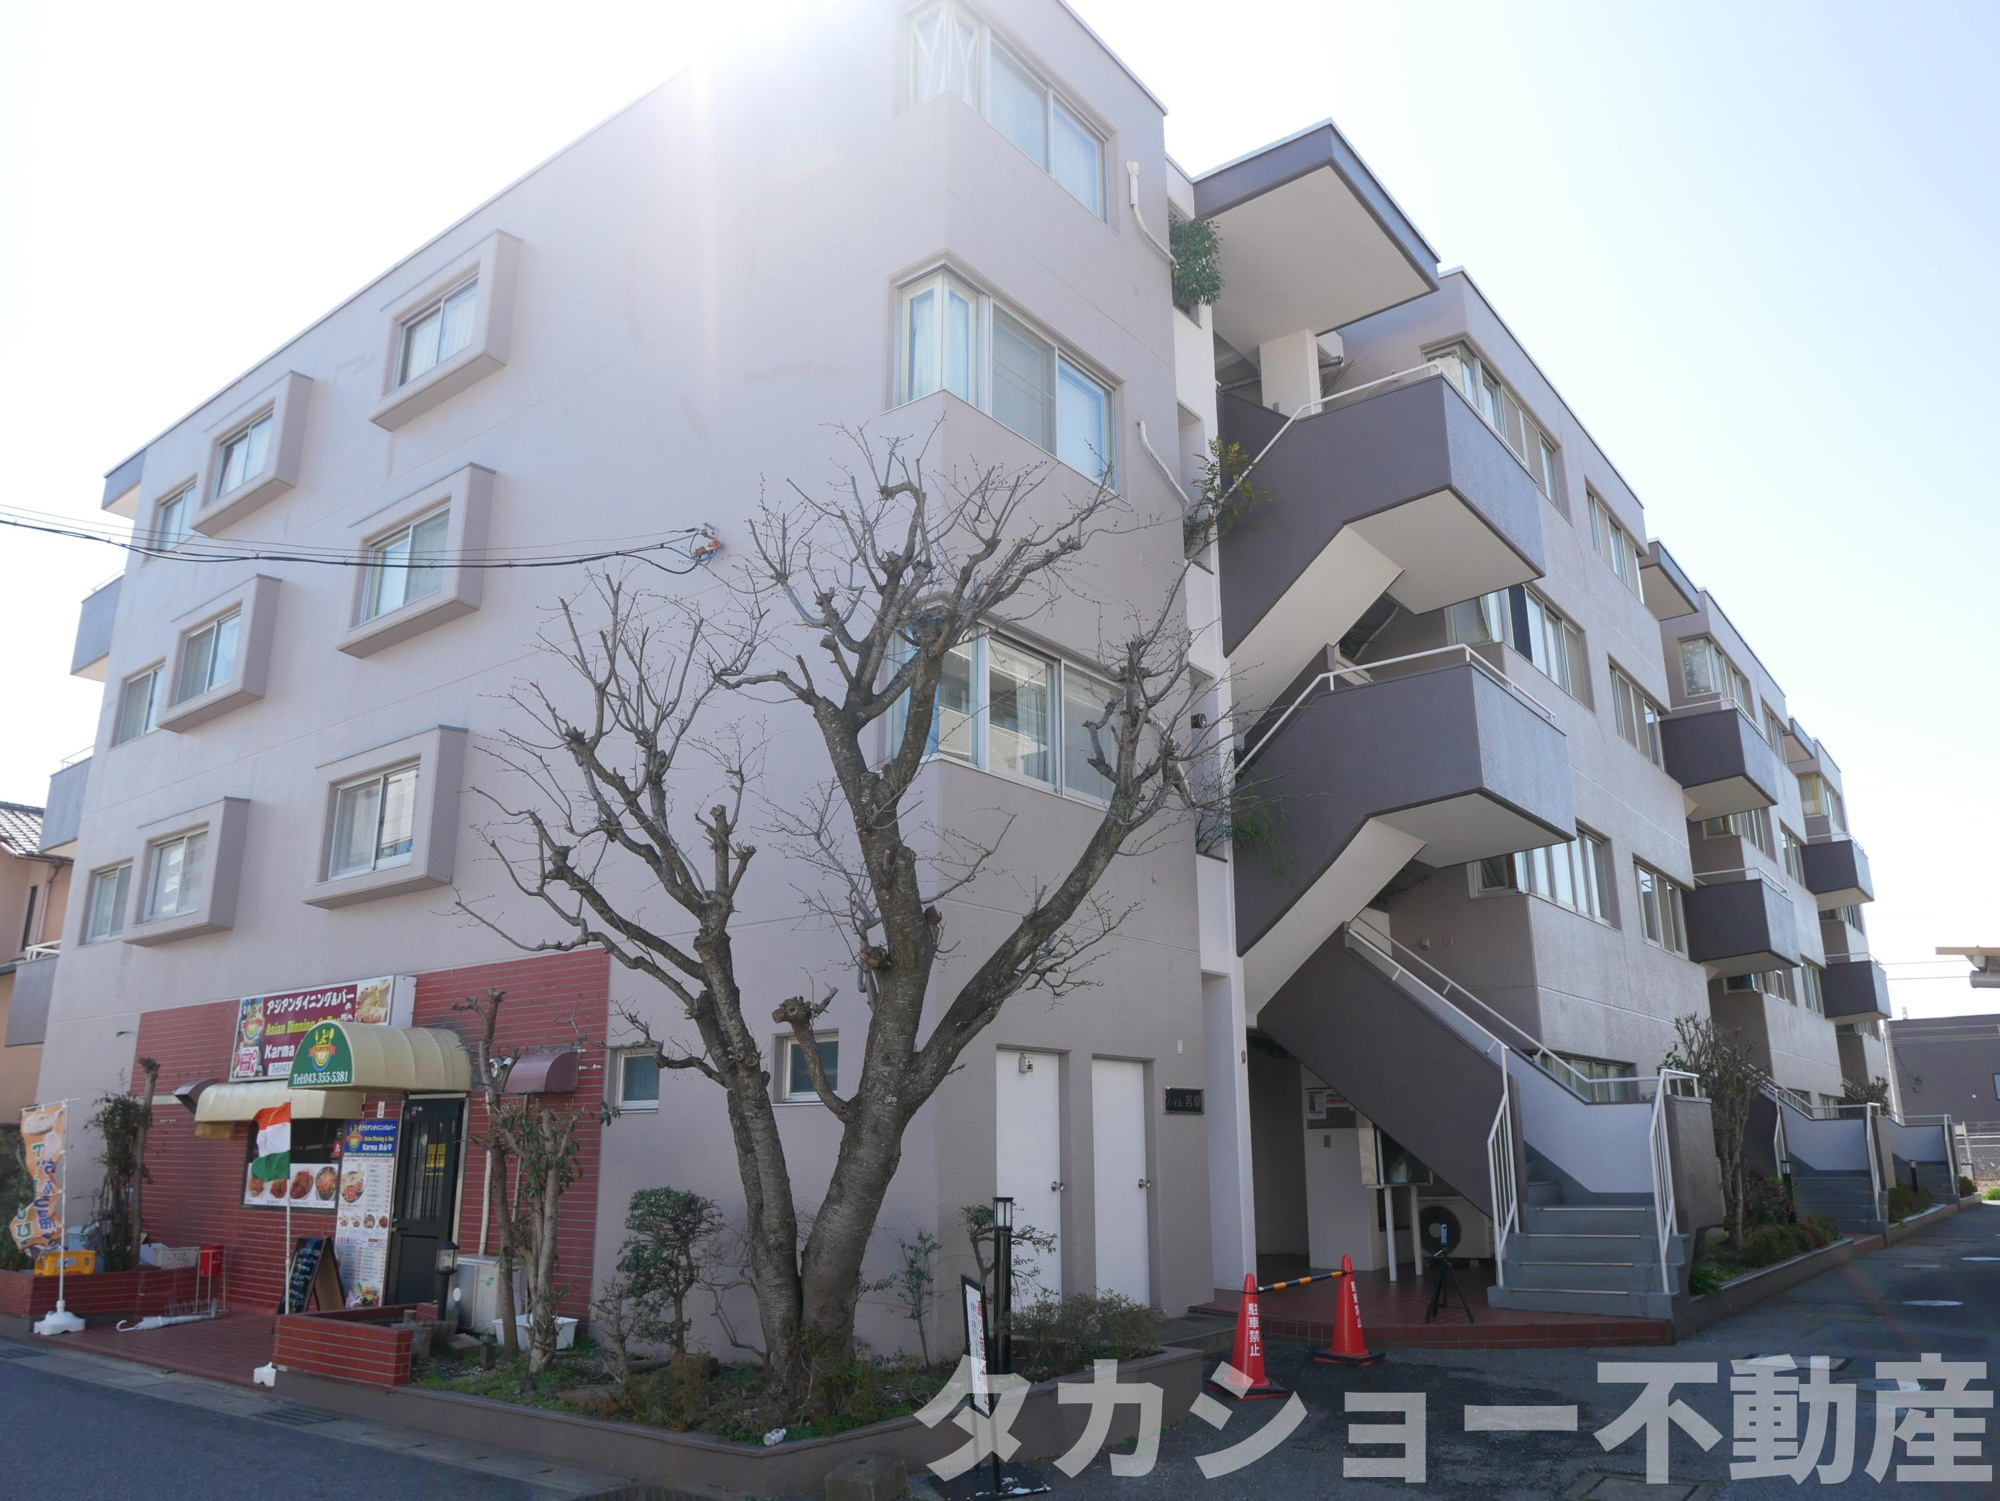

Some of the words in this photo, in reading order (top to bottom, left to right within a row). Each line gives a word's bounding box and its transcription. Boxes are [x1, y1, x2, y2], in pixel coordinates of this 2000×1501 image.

[264, 1044, 295, 1059] Karma
[1248, 1303, 1260, 1357] 駐車禁止
